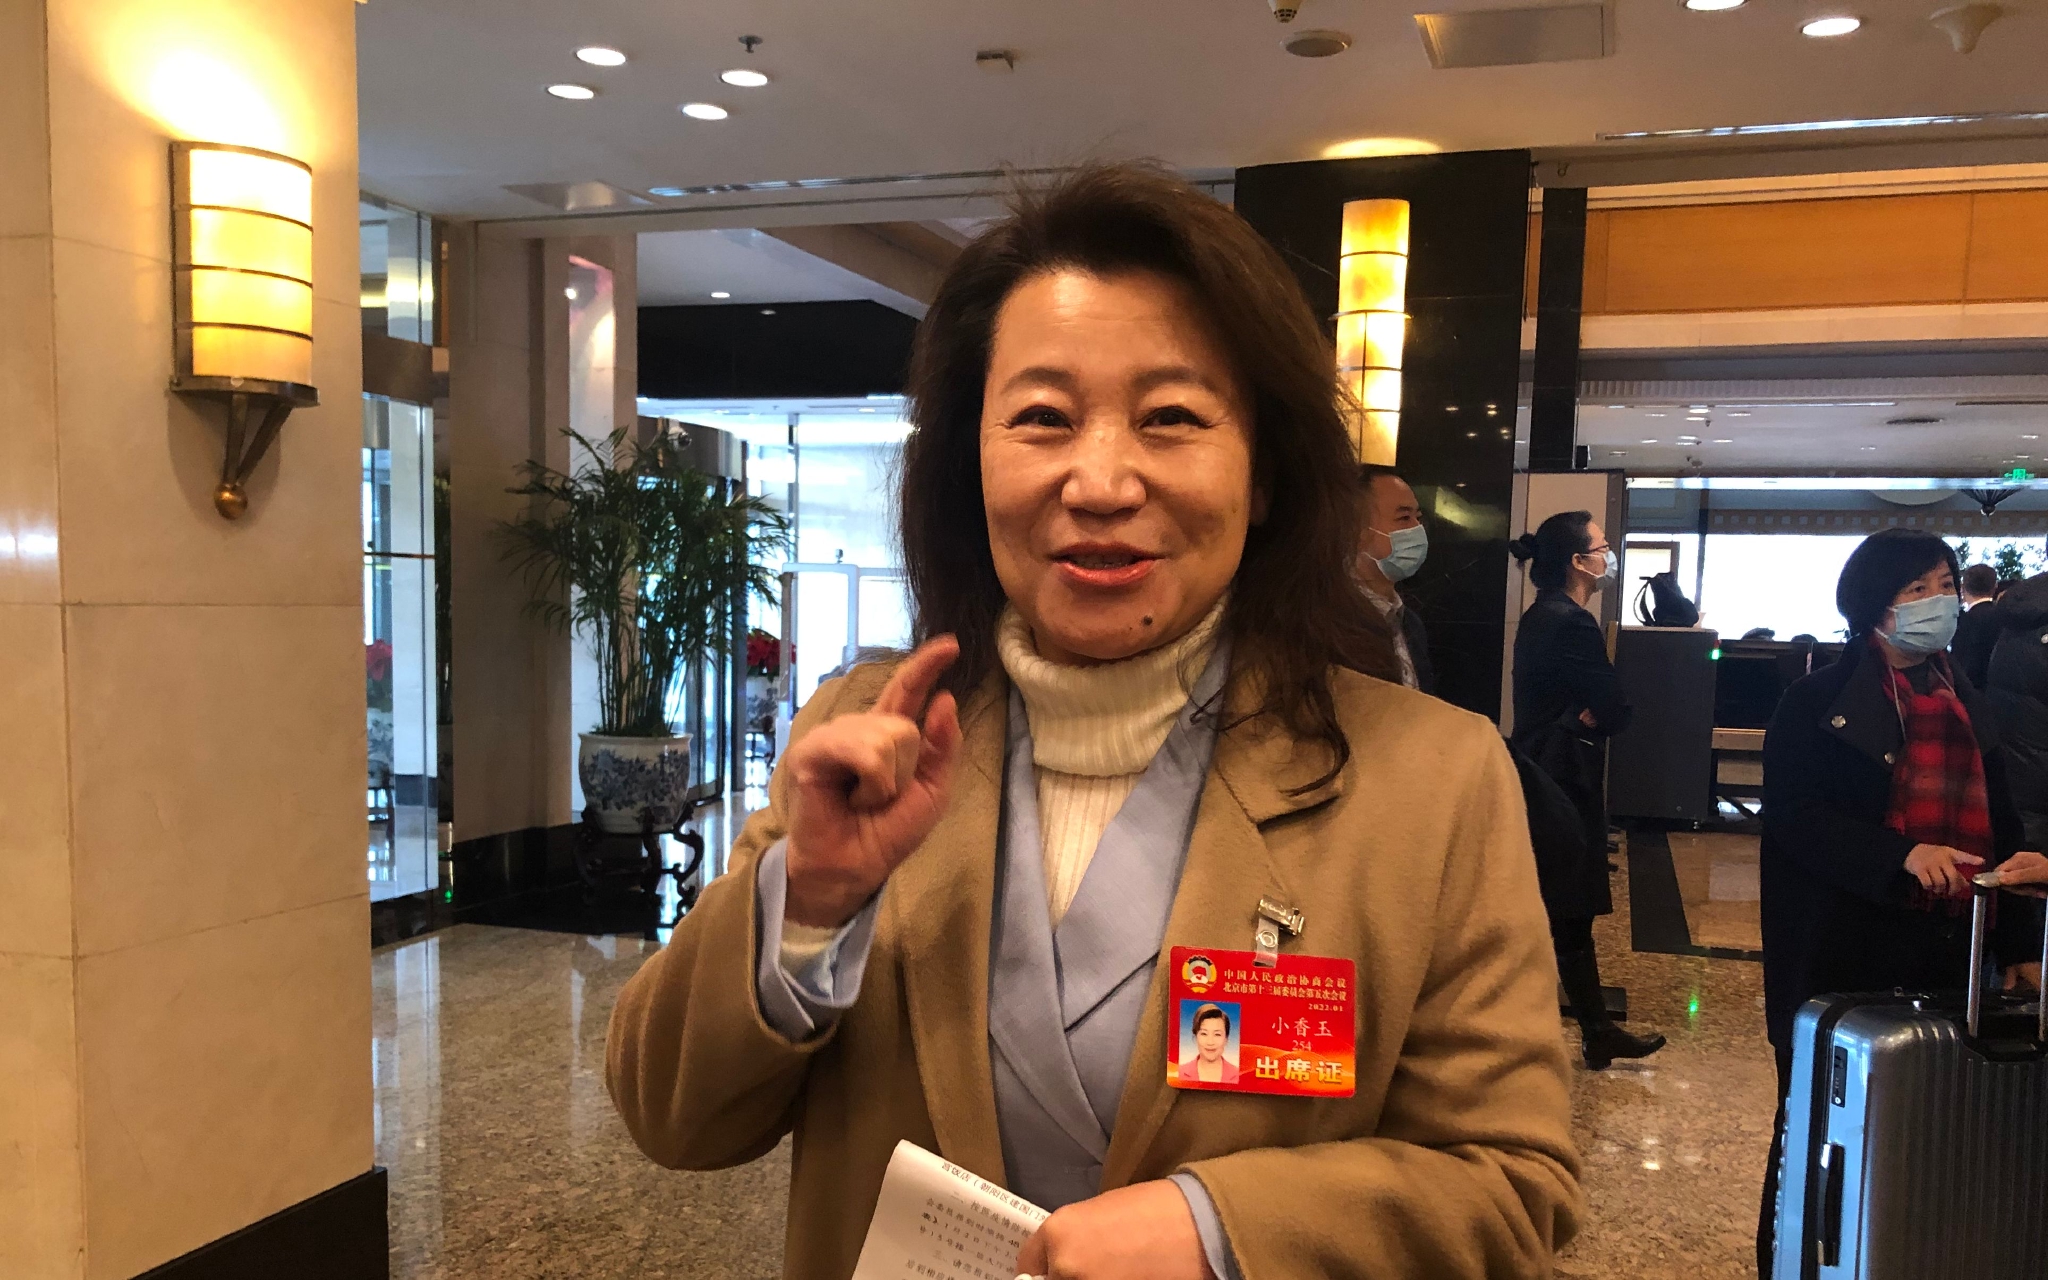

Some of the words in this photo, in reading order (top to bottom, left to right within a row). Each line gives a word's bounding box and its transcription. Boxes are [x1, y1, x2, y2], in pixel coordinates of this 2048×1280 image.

[1224, 969, 1346, 988] 中国人民政治协商会议
[1223, 982, 1347, 1001] 北京市第十三届委员会第五次会议
[1308, 1003, 1344, 1012] 2022.01
[1271, 1016, 1333, 1037] 小香玉
[1292, 1039, 1312, 1052] 254
[1255, 1056, 1343, 1084] 出席证
